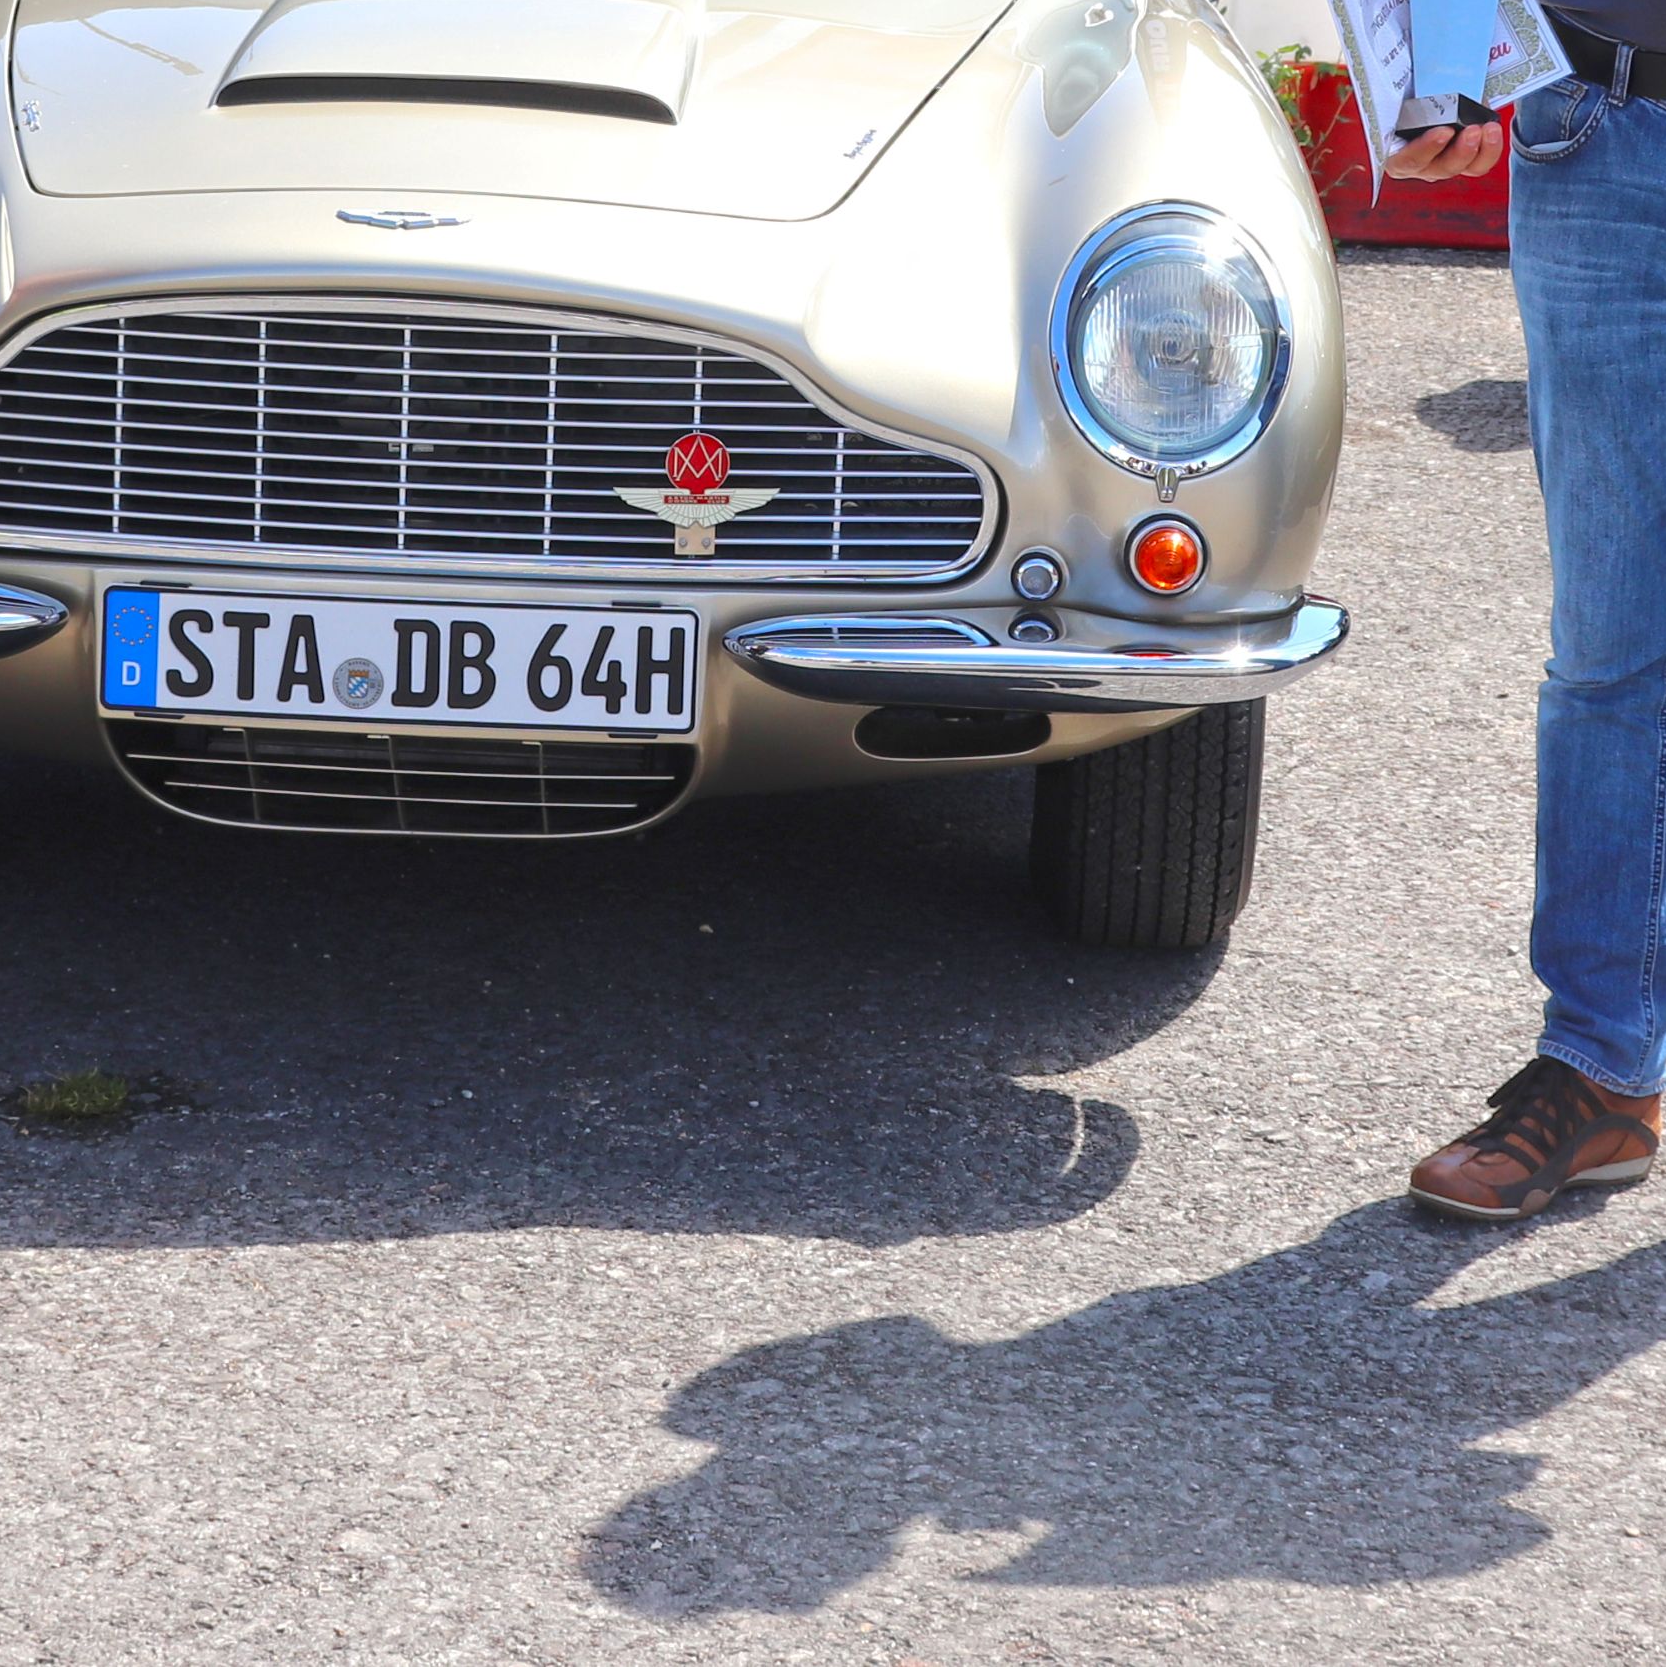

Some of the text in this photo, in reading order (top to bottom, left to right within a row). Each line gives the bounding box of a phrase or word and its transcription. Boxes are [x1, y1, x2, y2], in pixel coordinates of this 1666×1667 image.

[121, 661, 141, 685] D
[165, 609, 685, 715] STA DB 64H
